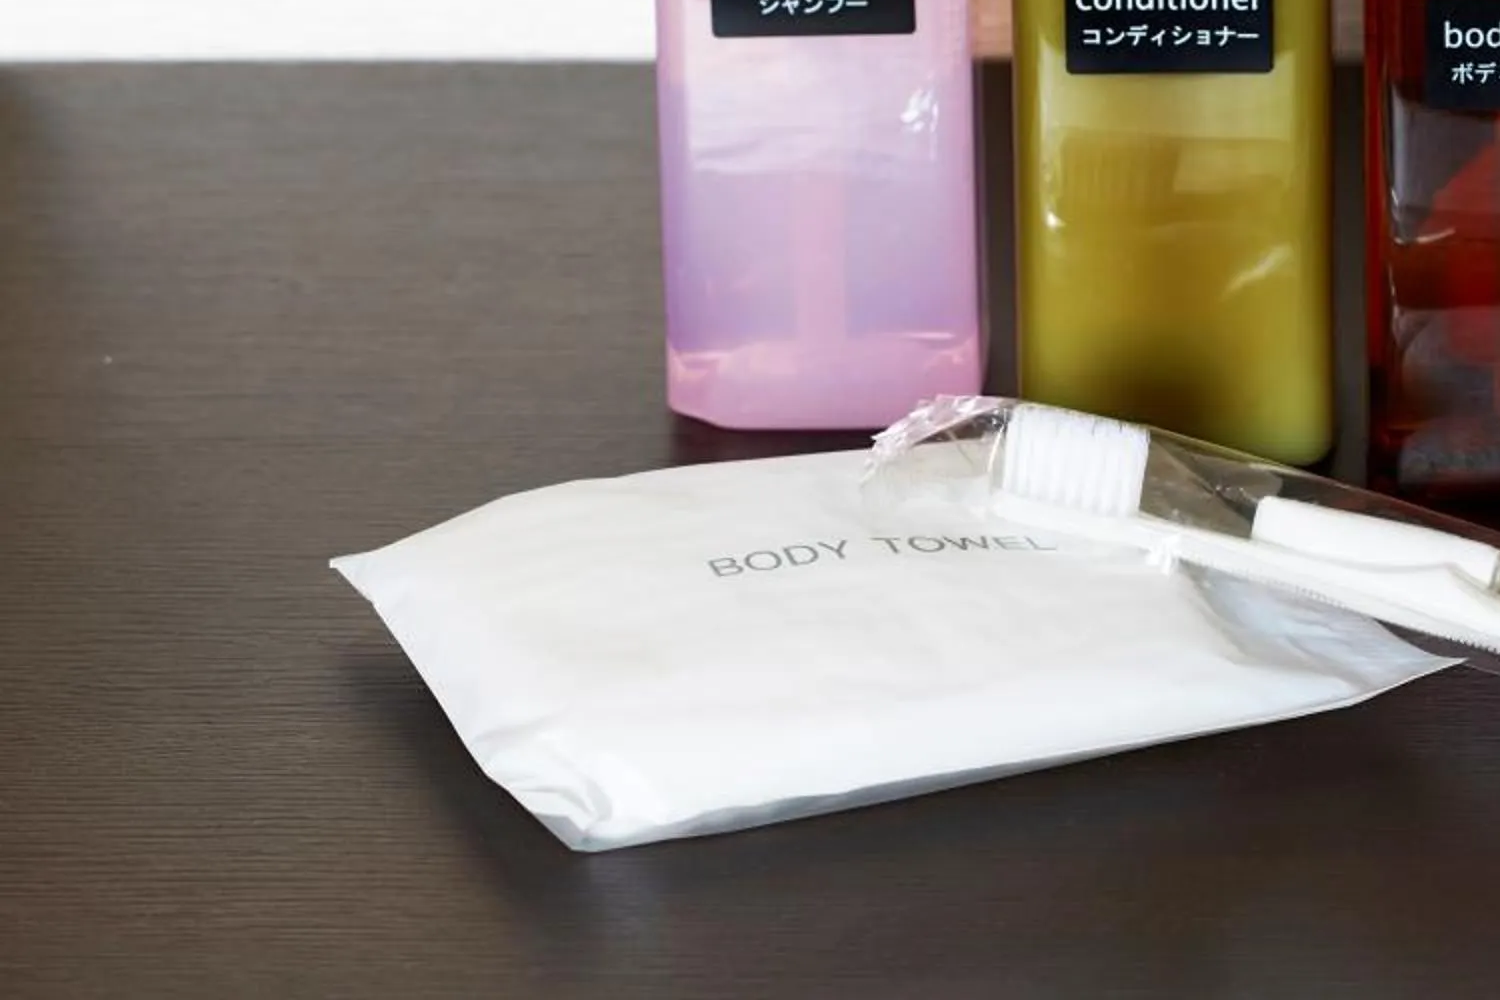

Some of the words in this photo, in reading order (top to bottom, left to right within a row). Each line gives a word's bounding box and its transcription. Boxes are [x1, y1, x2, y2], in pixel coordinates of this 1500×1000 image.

[1082, 24, 1259, 47] コンディショナー
[707, 538, 850, 578] BODY
[871, 535, 1058, 556] TOWEL
